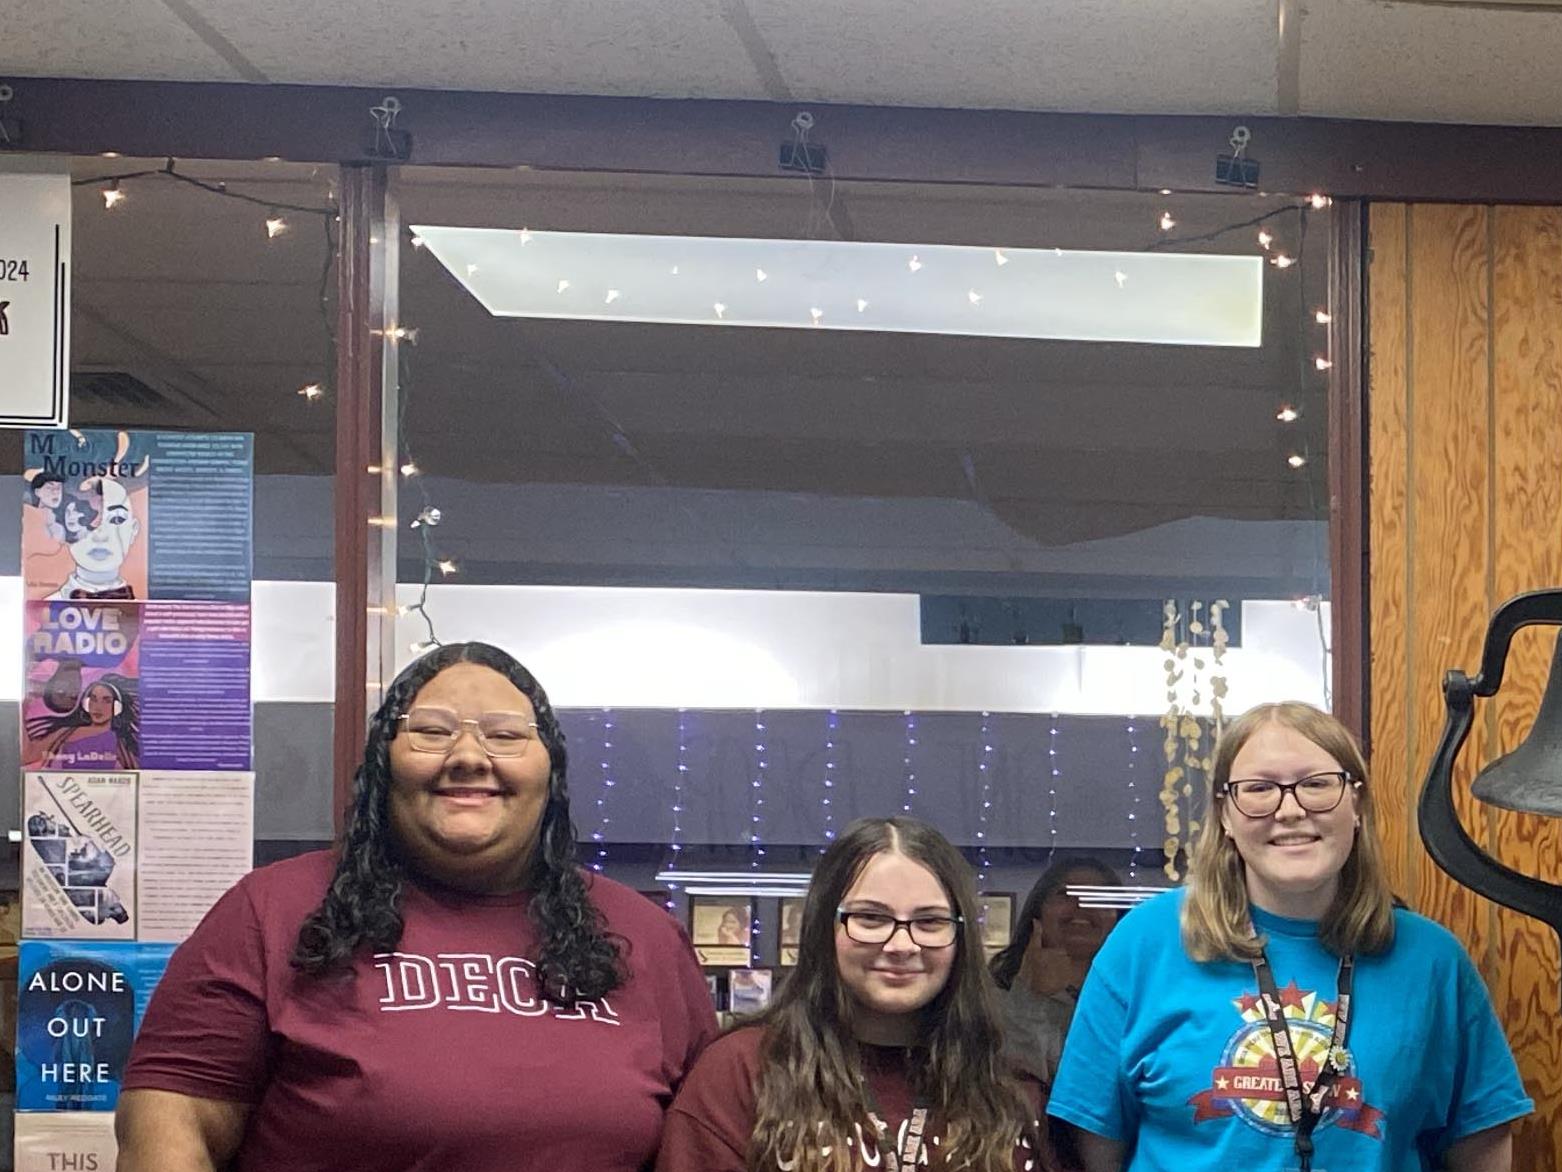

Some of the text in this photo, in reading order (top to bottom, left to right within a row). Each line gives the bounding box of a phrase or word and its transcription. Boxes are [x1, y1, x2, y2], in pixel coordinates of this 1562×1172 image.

[43, 455, 140, 477] Monster
[42, 606, 120, 631] LOVE
[33, 631, 128, 656] RADIO
[56, 776, 131, 857] SPEARHEAD
[28, 971, 125, 992] ALONE
[47, 1017, 107, 1038] OUT
[41, 1063, 110, 1083] HERE
[1233, 1075, 1284, 1091] GREATE
[47, 1152, 99, 1172] THIS
